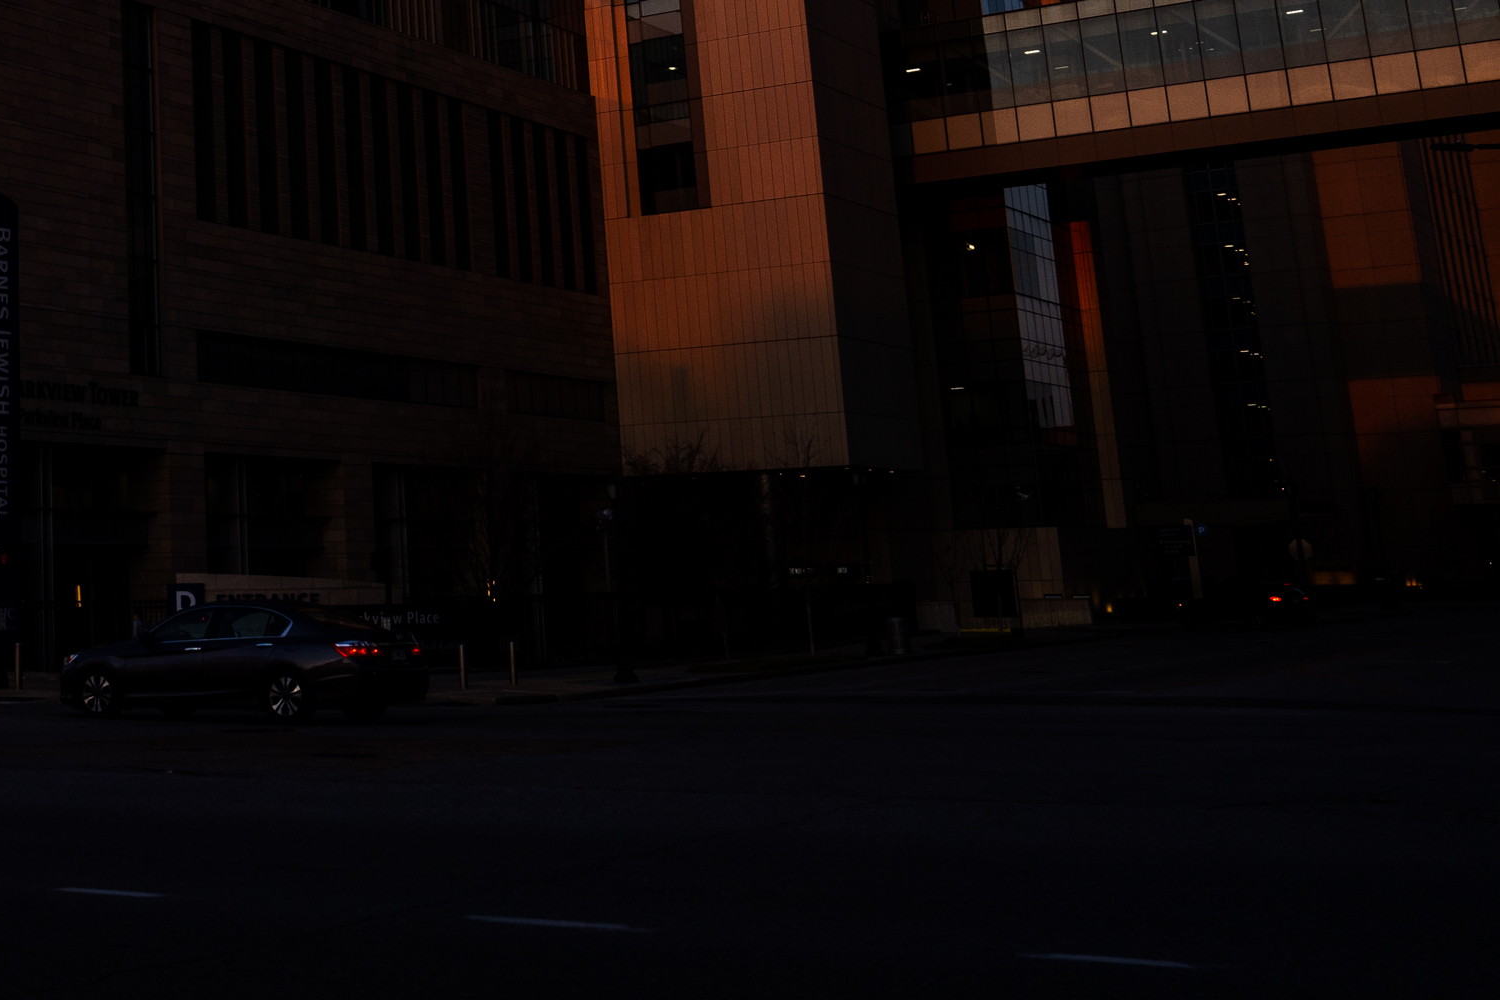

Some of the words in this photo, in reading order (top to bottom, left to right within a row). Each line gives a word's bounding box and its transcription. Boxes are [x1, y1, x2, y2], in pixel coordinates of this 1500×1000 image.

[18, 379, 86, 403] ARKVIEW
[88, 381, 139, 408] TOWER
[71, 411, 102, 431] Place
[406, 610, 440, 625] Place
